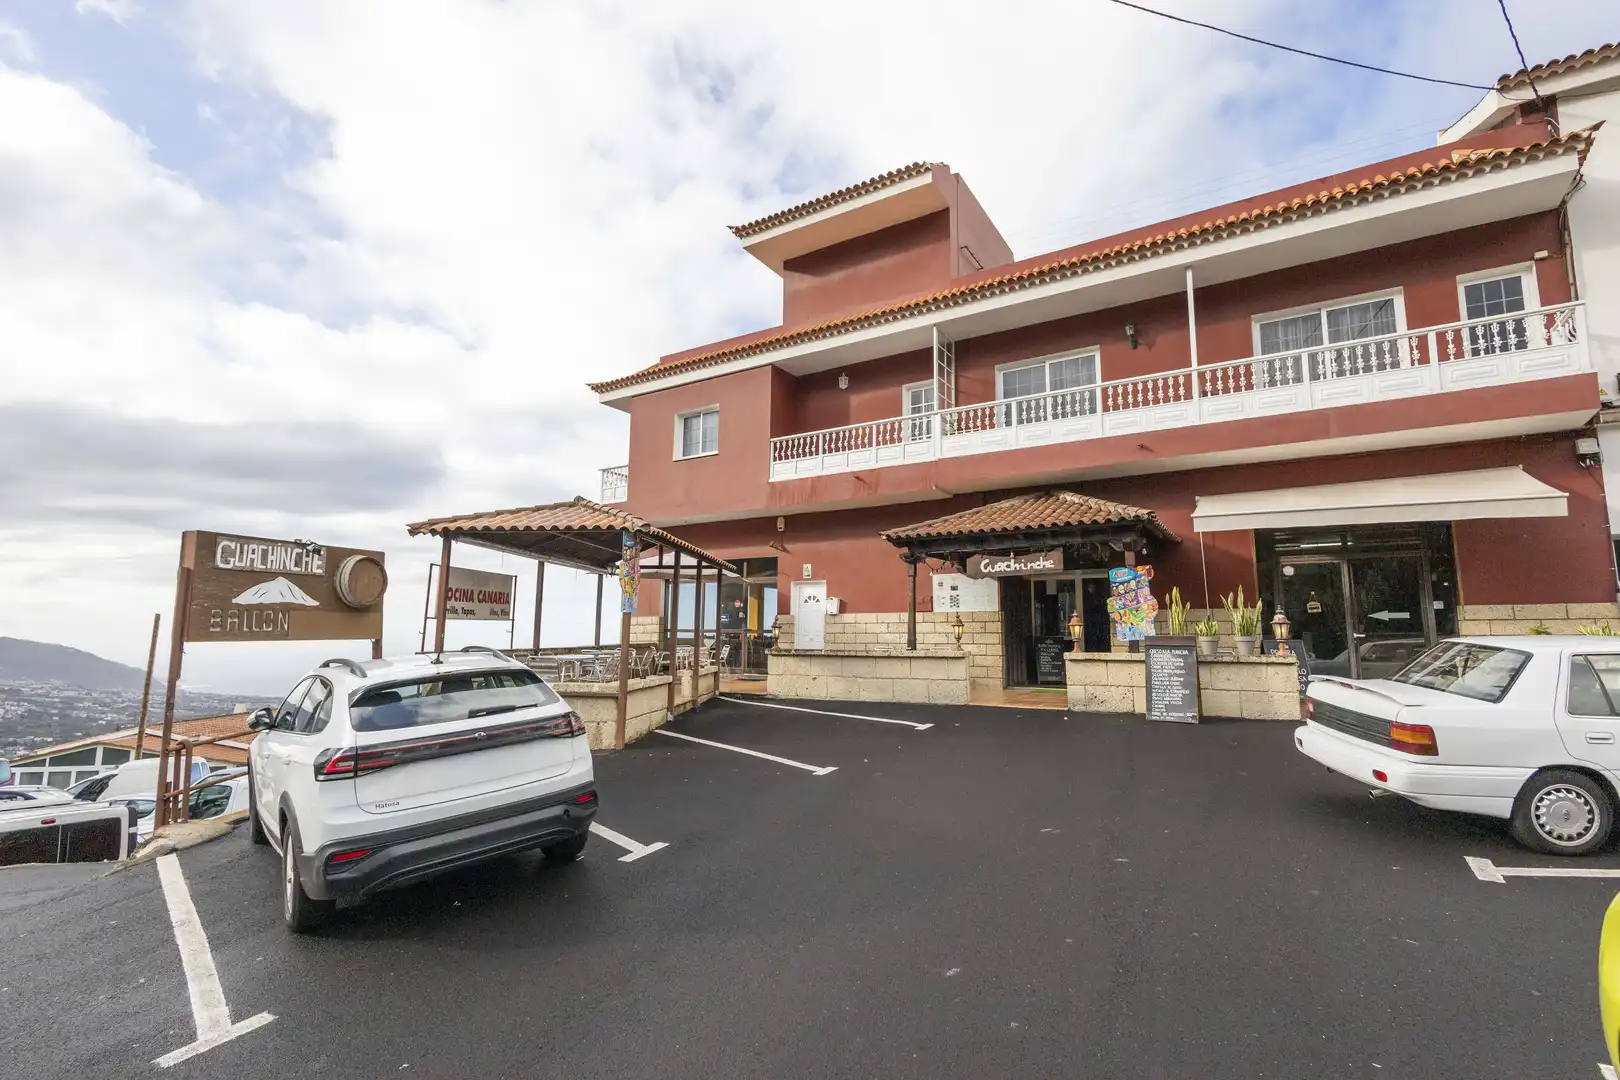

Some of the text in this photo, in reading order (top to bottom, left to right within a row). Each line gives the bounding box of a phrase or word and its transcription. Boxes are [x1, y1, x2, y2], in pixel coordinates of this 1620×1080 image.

[216, 541, 323, 573] GUACHINCHE
[447, 587, 510, 605] OCINA CANARIA
[209, 609, 289, 633] BALCON
